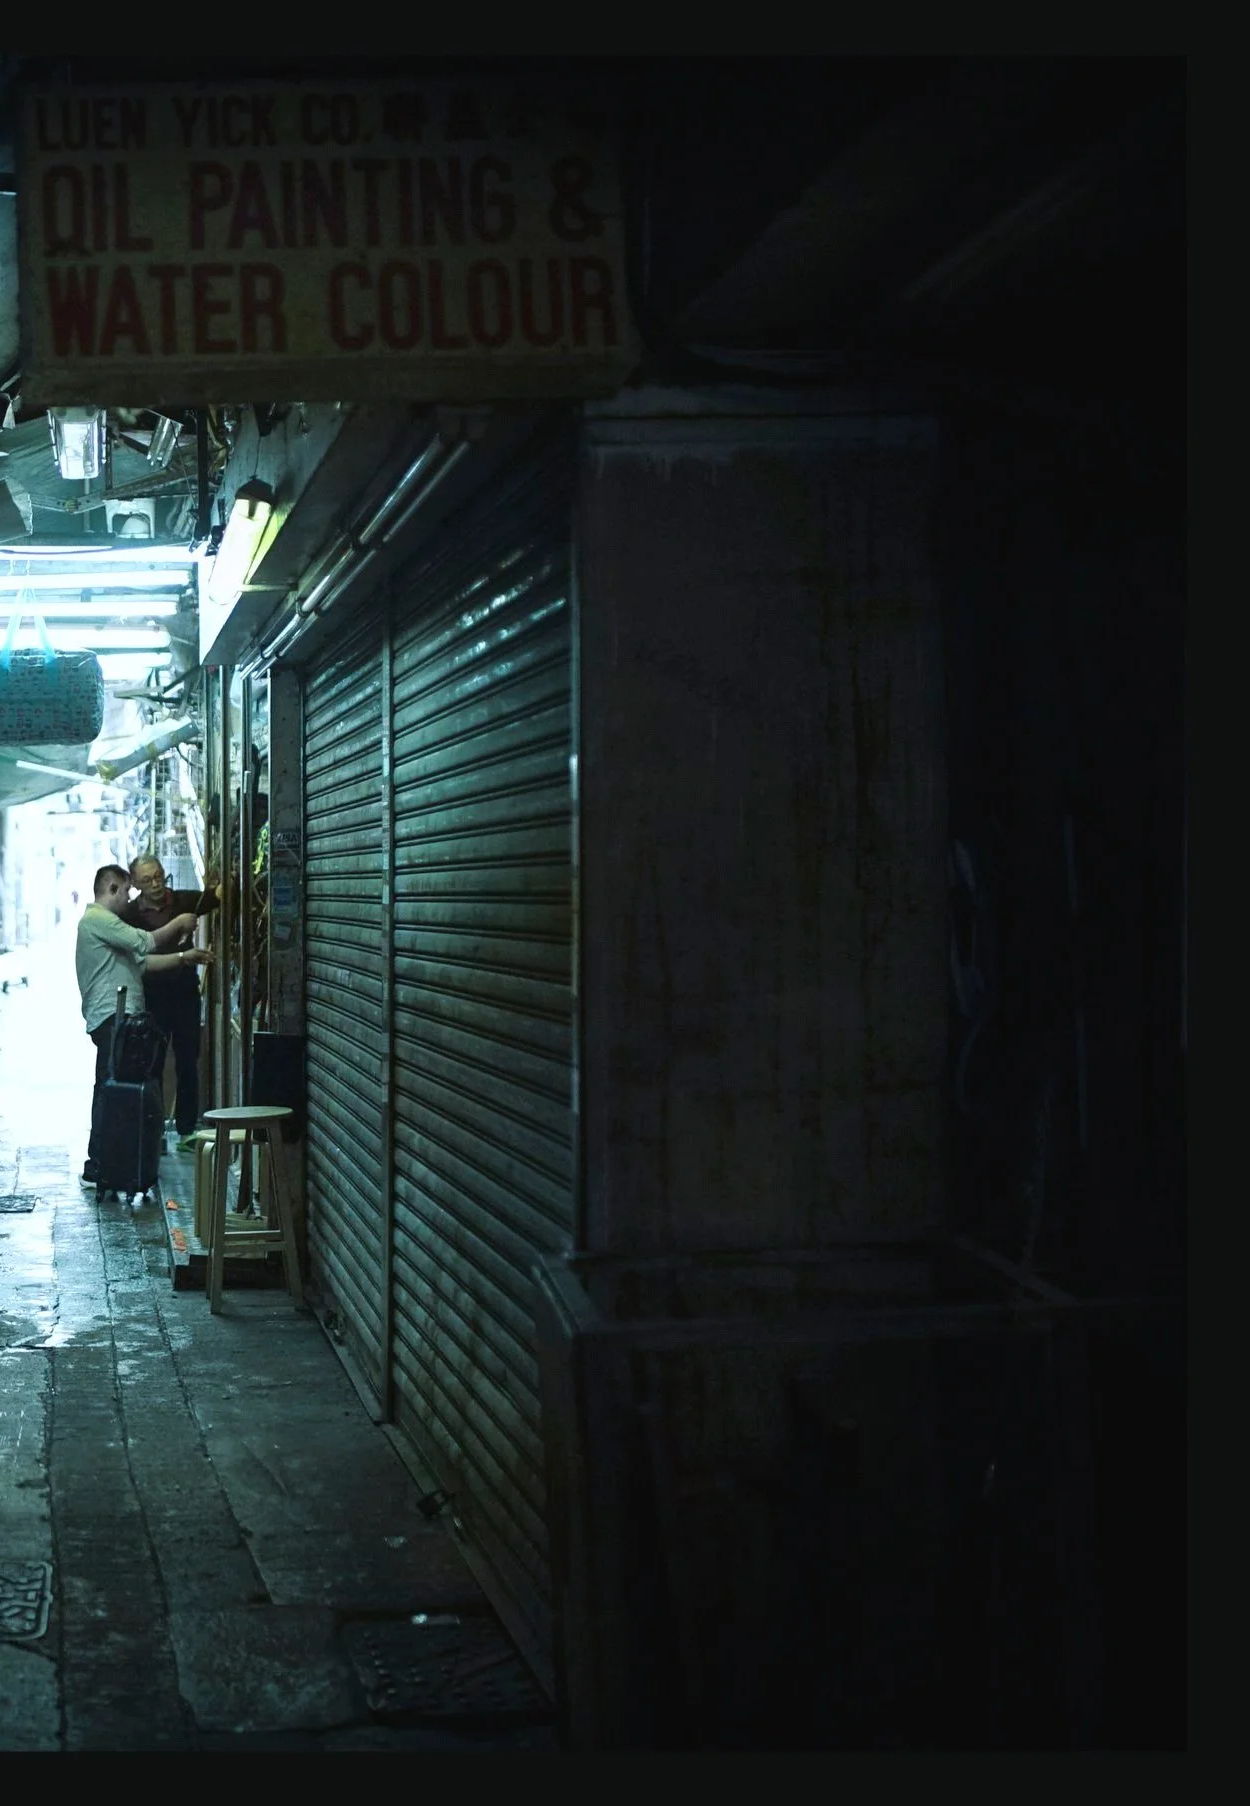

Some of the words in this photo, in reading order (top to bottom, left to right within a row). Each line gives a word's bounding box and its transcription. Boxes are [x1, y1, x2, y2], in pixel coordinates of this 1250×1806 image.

[36, 95, 146, 150] LUEN
[172, 94, 278, 147] YICK
[300, 93, 371, 146] CO.
[42, 162, 152, 253] OIL
[189, 154, 516, 249] PAINTING
[549, 155, 606, 242] &
[47, 263, 287, 358] WATER
[327, 256, 618, 351] COLOUR
